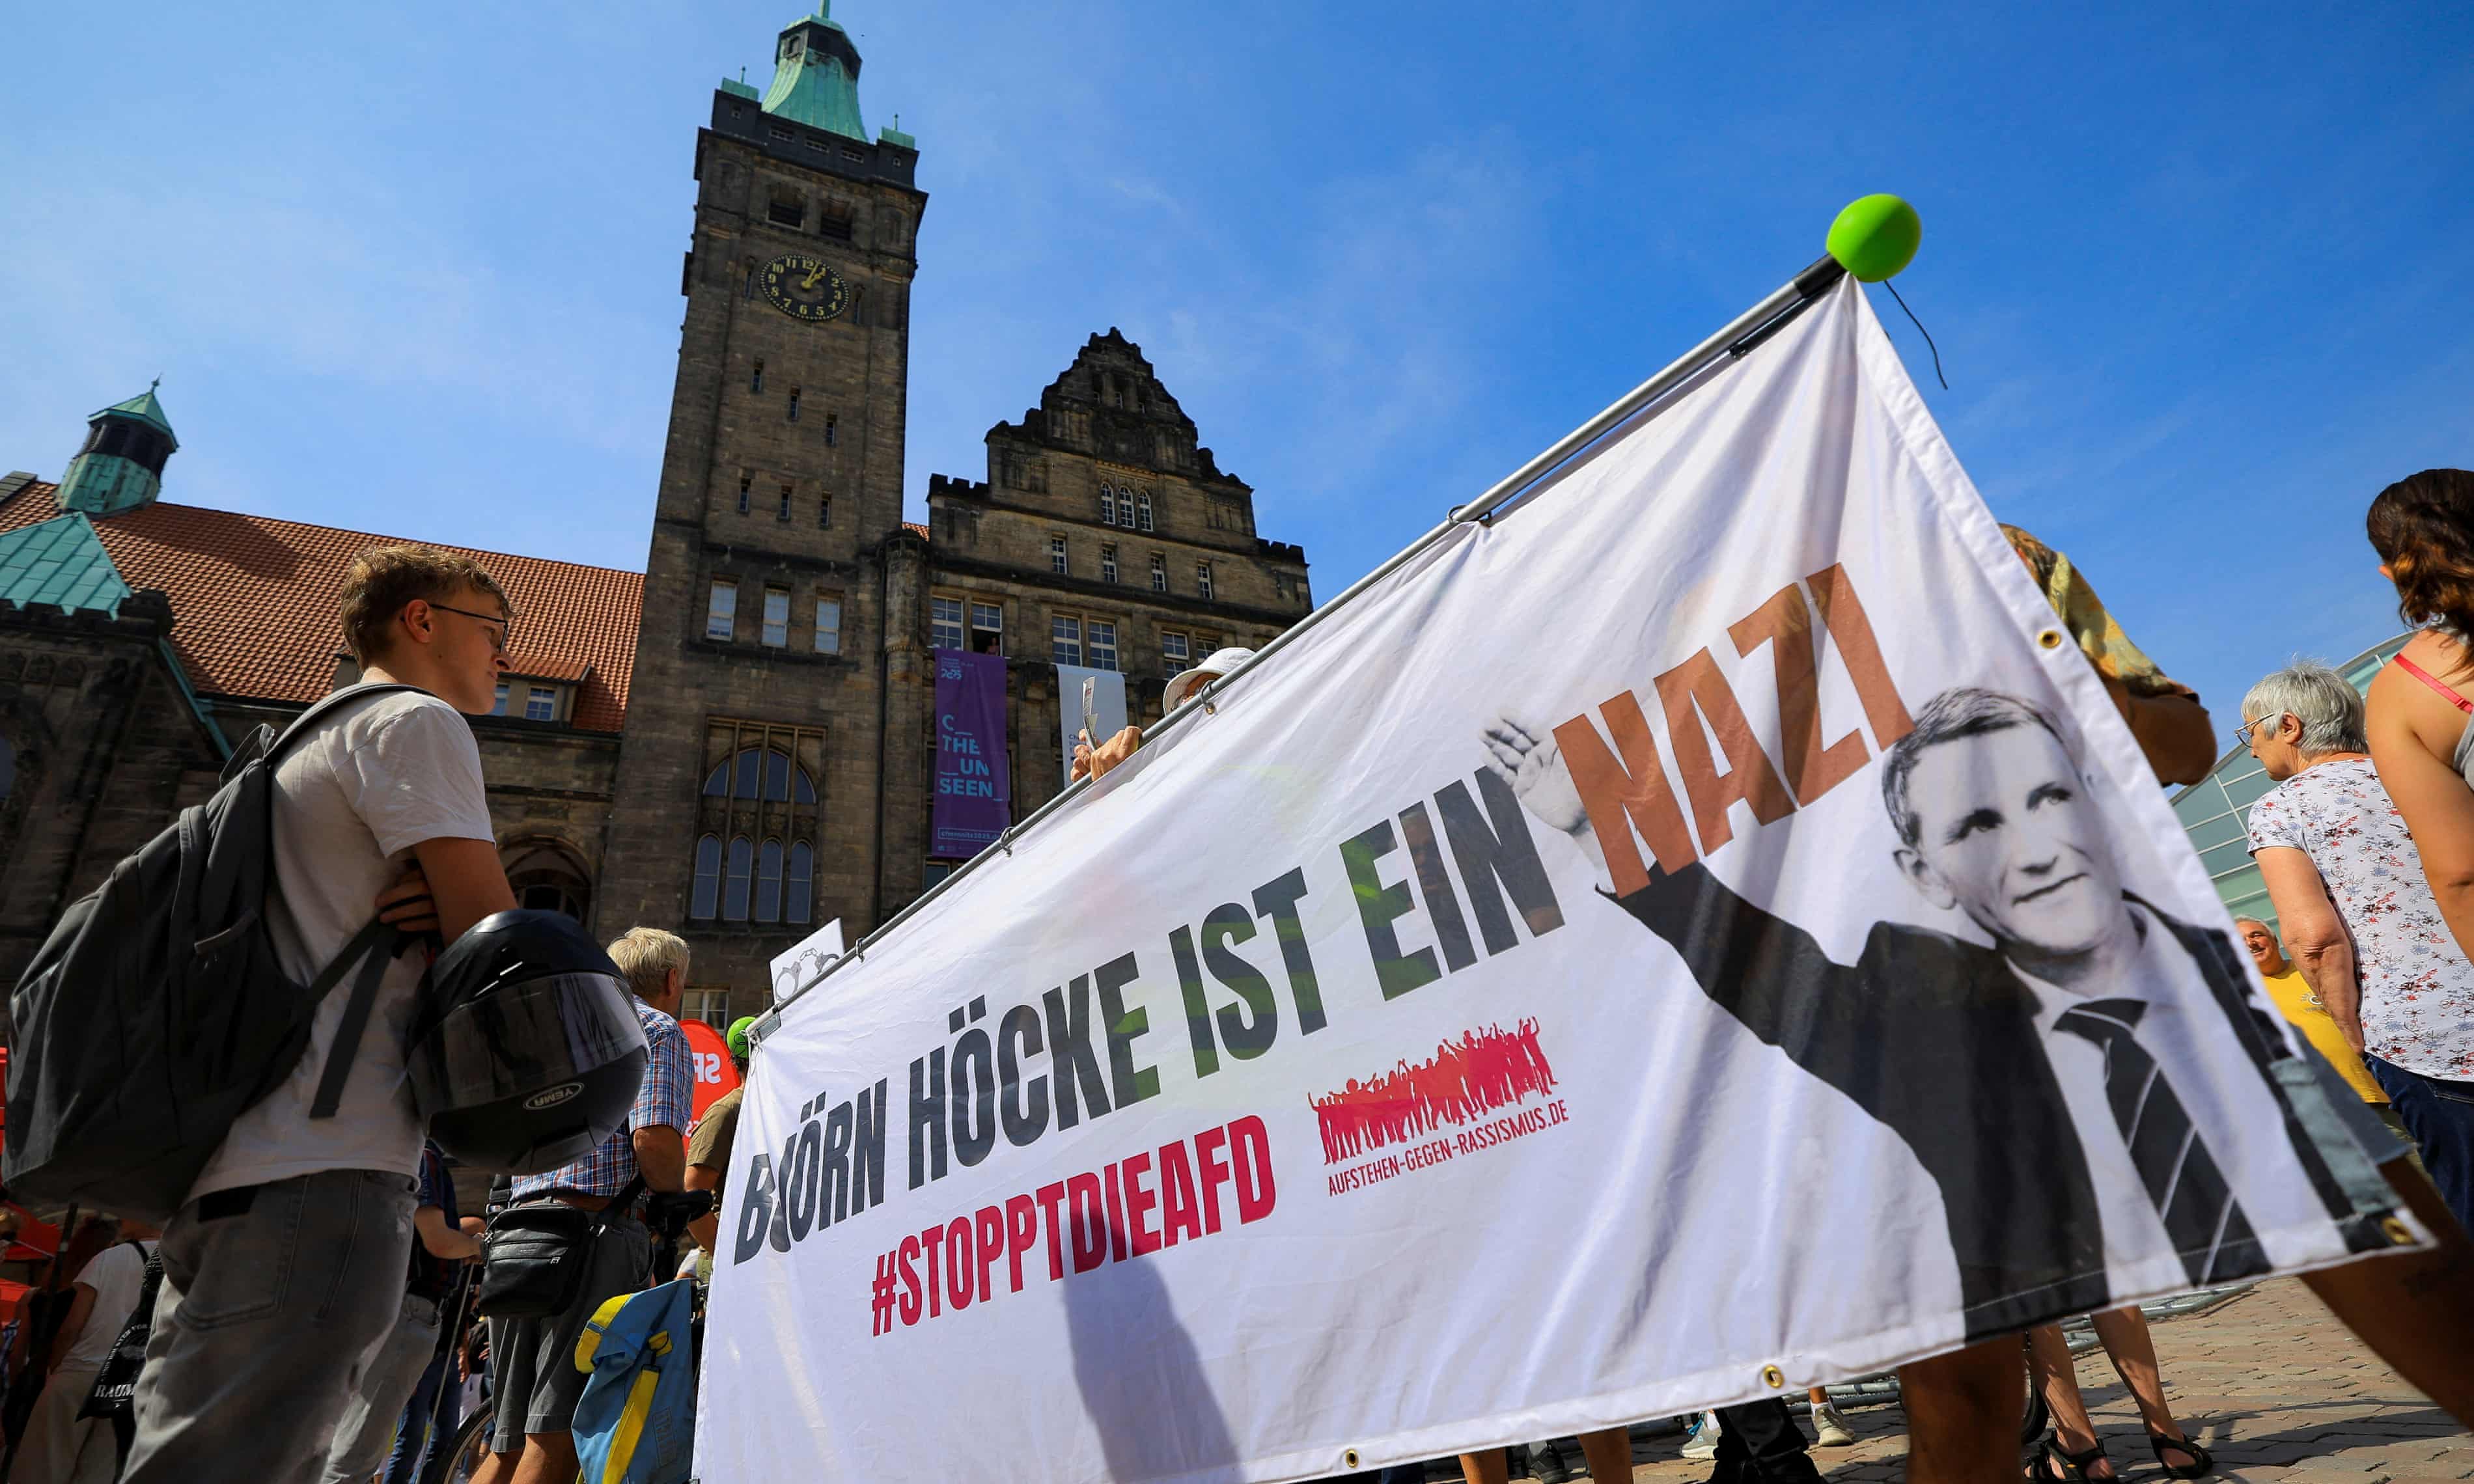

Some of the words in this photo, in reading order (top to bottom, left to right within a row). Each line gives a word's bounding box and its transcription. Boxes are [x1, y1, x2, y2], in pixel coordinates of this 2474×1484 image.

[772, 263, 785, 273] 10
[786, 258, 797, 268] 11
[801, 259, 814, 269] 12
[768, 273, 777, 284] 9
[831, 277, 840, 288] 2
[771, 286, 779, 297] 8
[833, 290, 841, 300] 3
[783, 297, 792, 308] 7
[828, 301, 837, 310] 4
[799, 305, 807, 315] 6
[816, 306, 824, 316] 5
[942, 734, 980, 755] THE
[734, 1077, 887, 1266] BJÖRN
[908, 951, 1161, 1191] HÖCKE
[1169, 867, 1328, 1079] IST
[1339, 765, 1565, 1001] EIN
[1552, 562, 1917, 899] NAZI
[1328, 1099, 1569, 1197] AUFSTEHEN-GEGEN-RASSISMUS.DE
[872, 1114, 1277, 1338] #STOPPTDIEAFD
